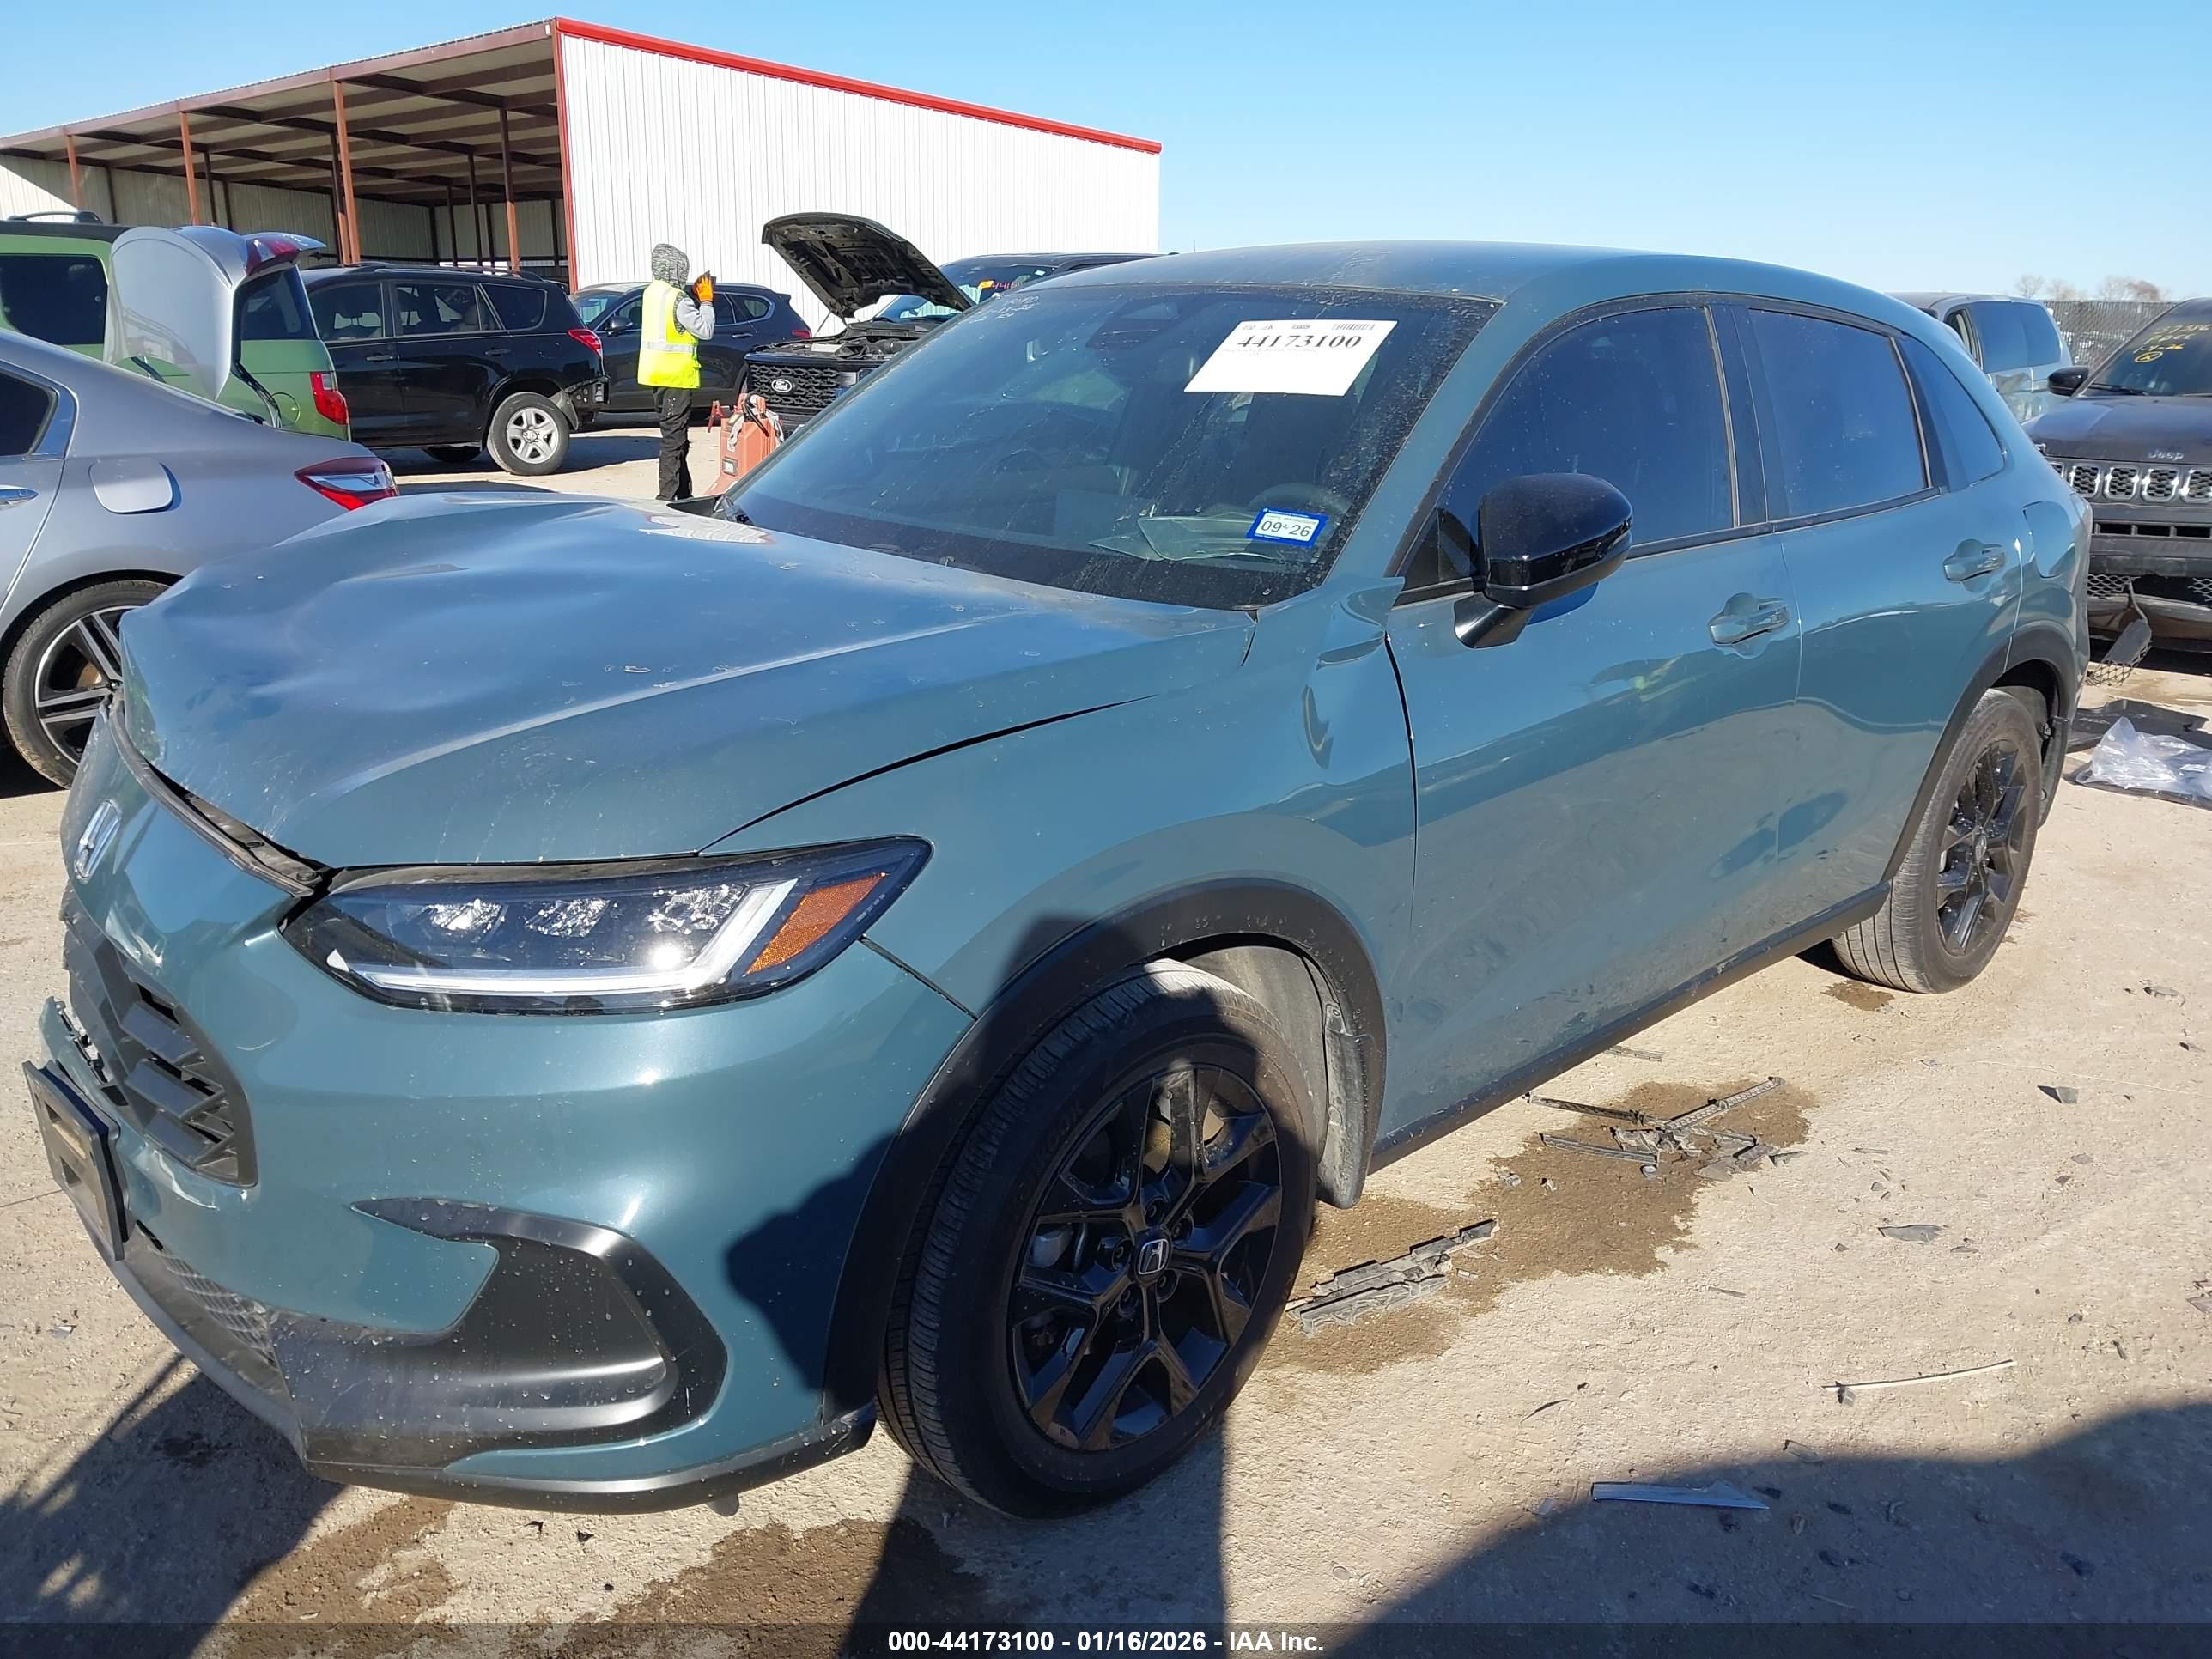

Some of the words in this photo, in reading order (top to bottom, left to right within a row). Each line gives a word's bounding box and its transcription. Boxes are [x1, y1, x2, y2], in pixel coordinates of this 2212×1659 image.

[1237, 334, 1363, 349] 44173100
[774, 380, 789, 391] Ford
[2148, 449, 2185, 461] Jeep
[1261, 520, 1283, 532] 09
[1289, 524, 1313, 537] 26
